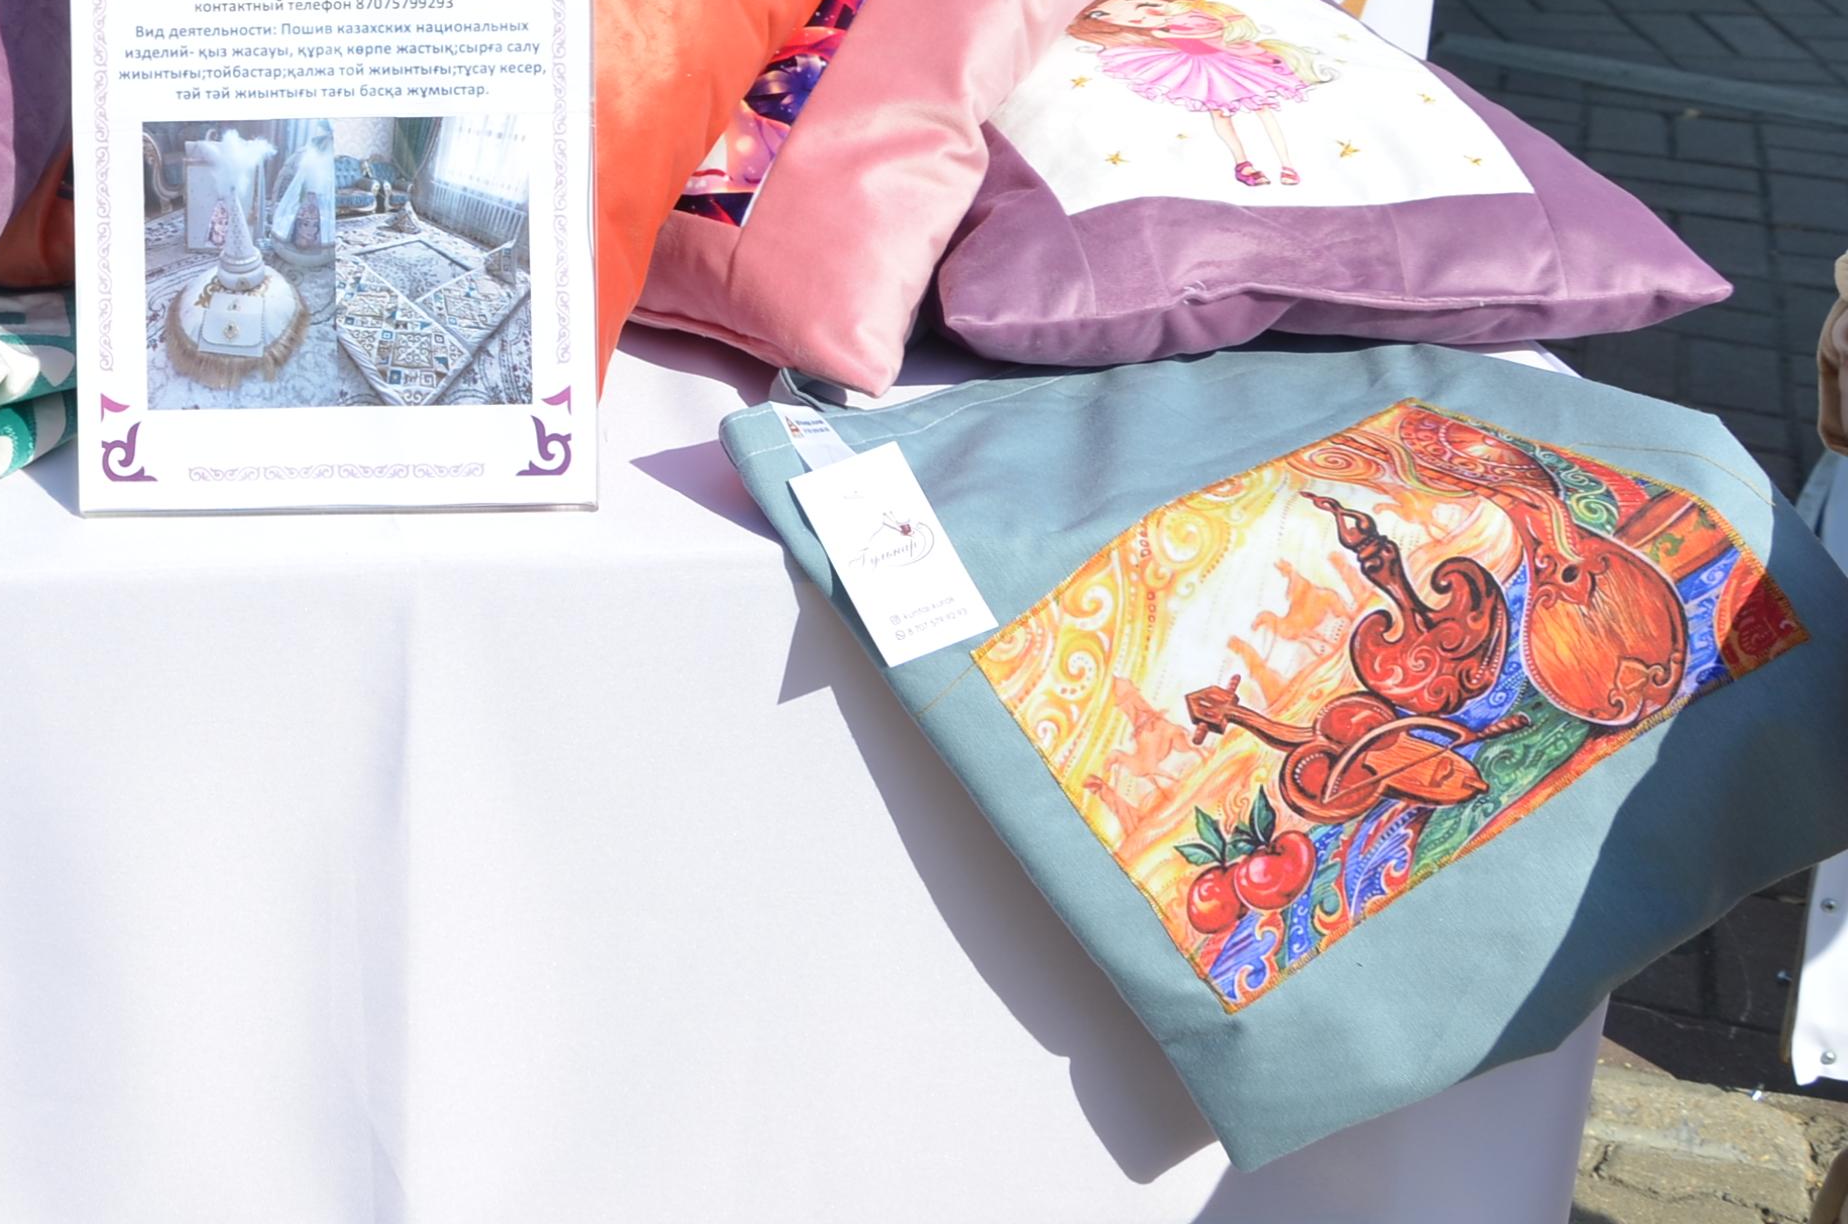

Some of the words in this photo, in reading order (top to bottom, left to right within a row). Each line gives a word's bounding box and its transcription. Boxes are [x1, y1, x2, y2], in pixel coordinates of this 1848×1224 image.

[135, 25, 166, 40] Вид
[167, 25, 277, 40] деятельности:
[280, 22, 333, 36] Пошив
[336, 23, 412, 35] казахских
[415, 22, 529, 36] национальных
[198, 47, 228, 61] қыз
[231, 46, 294, 60] жасауы,
[297, 45, 343, 59] құрақ
[346, 44, 393, 58] көрпе
[506, 42, 541, 56] салу
[338, 62, 365, 77] той
[499, 63, 547, 76] кесер,
[175, 87, 201, 101] тәй
[204, 86, 231, 101] тәй
[234, 88, 318, 100] жиынтығы
[319, 87, 356, 98] тағы
[359, 83, 403, 99] басқа
